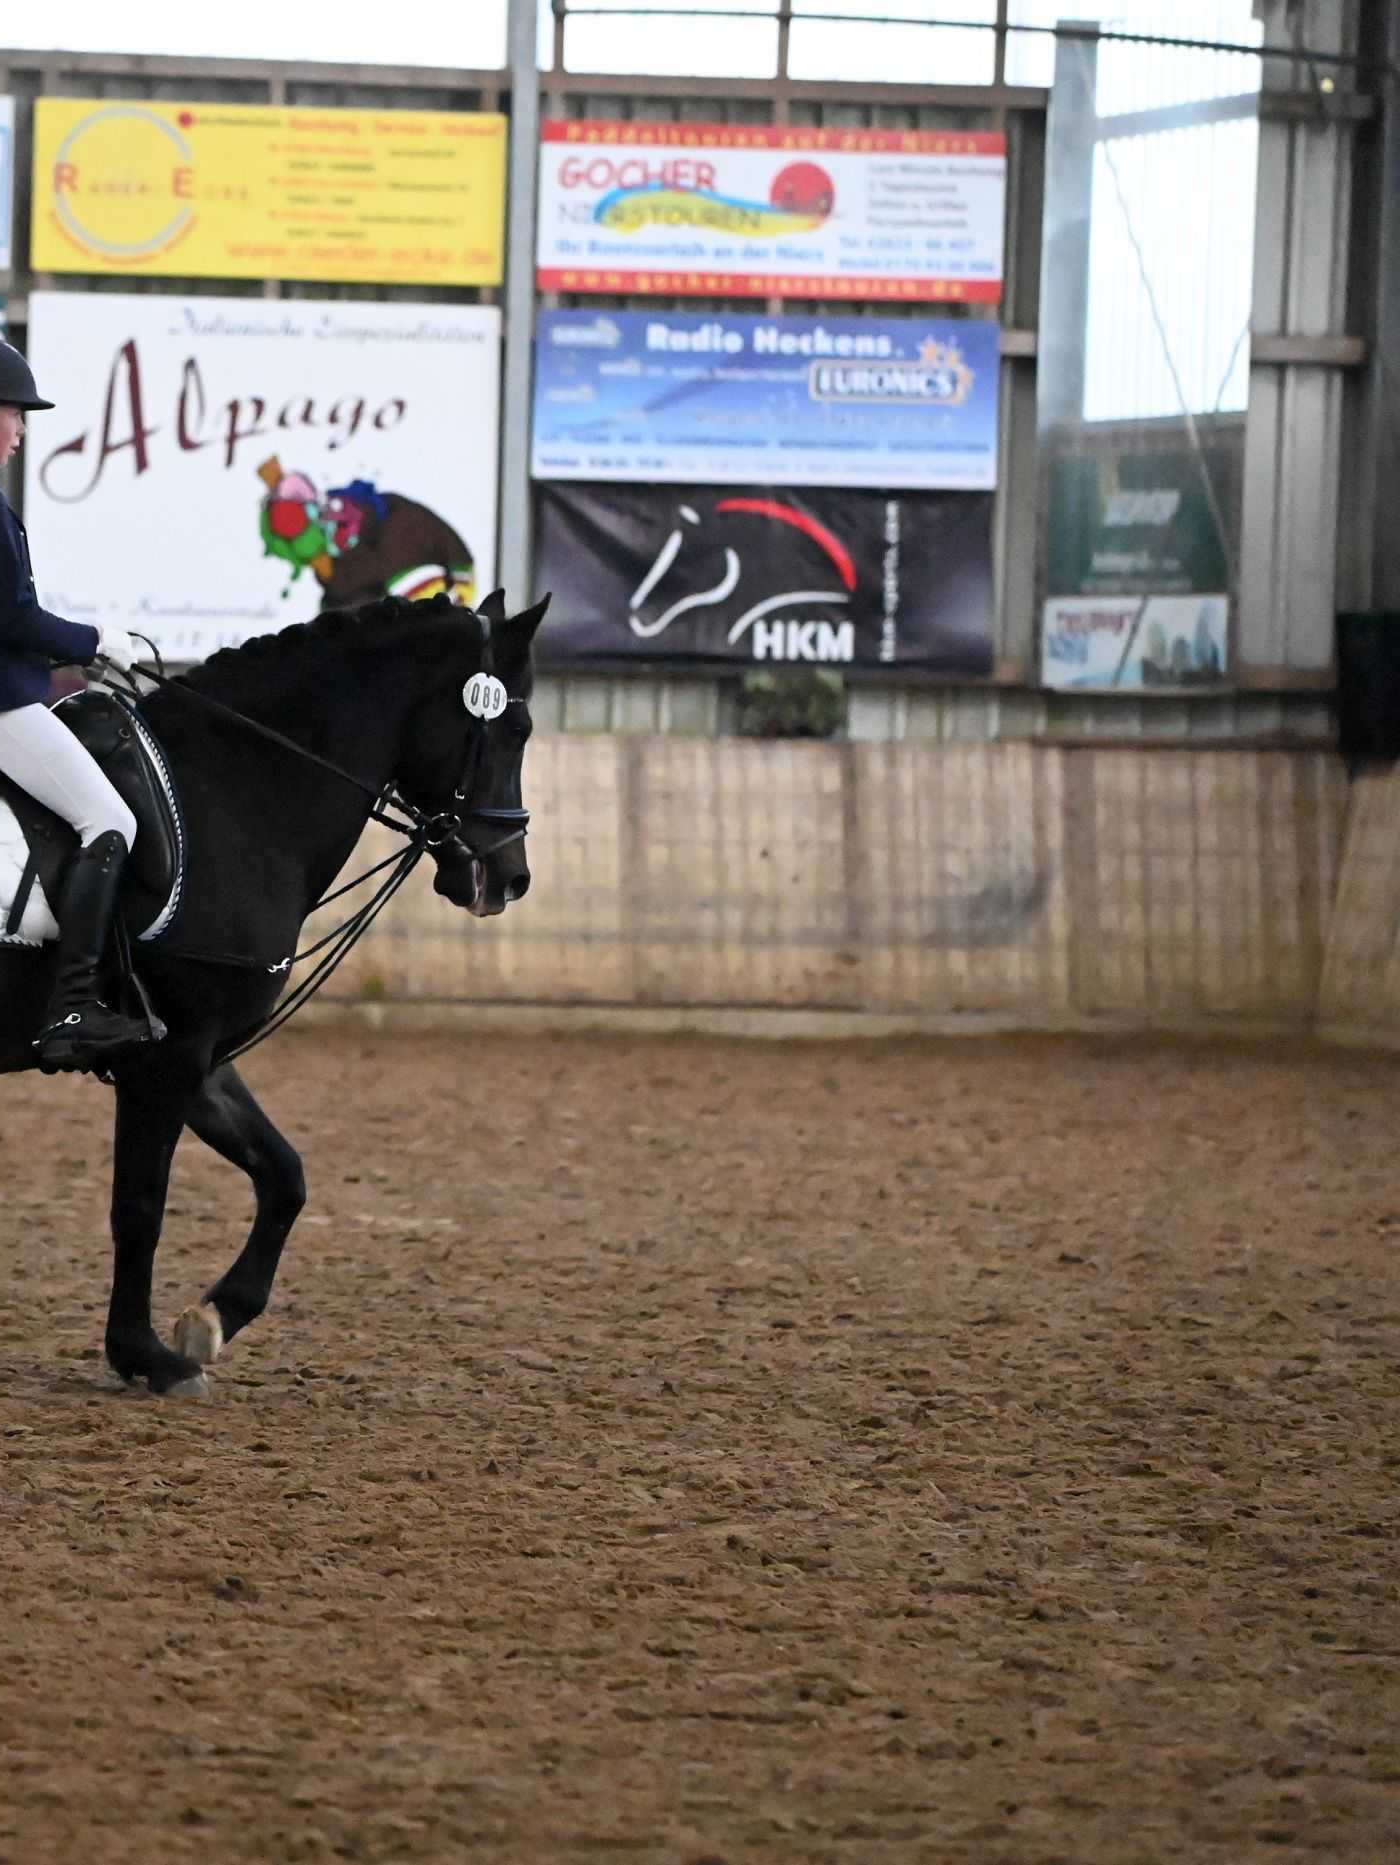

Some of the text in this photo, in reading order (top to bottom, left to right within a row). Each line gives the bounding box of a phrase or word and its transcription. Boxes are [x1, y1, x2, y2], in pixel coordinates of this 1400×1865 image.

[558, 157, 717, 191] GOCHER
[645, 322, 744, 353] Radio
[40, 339, 407, 503] Alpago
[752, 620, 855, 661] HKM
[470, 682, 501, 710] 089
